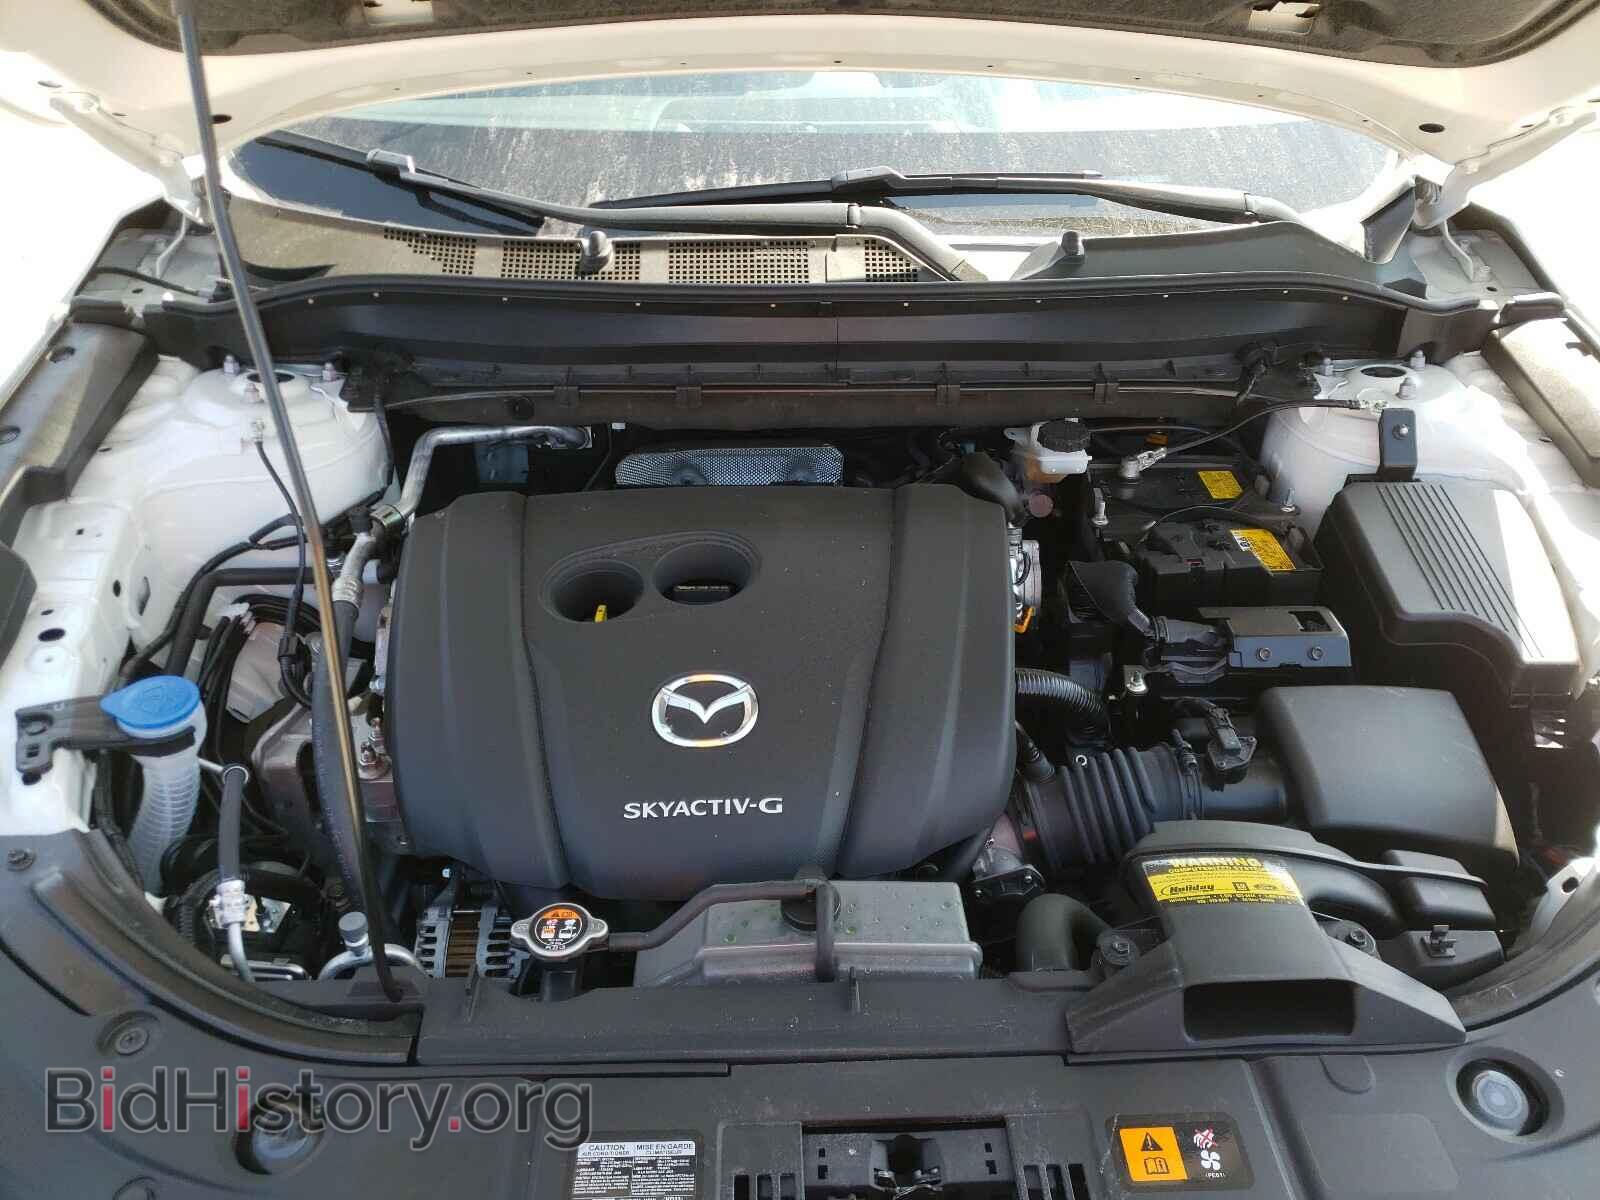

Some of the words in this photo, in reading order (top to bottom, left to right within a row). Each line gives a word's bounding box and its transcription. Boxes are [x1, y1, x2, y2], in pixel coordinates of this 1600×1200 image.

[623, 797, 783, 819] SKYACTIV-G
[1168, 857, 1262, 868] WARNING
[1170, 883, 1215, 895] Holiday
